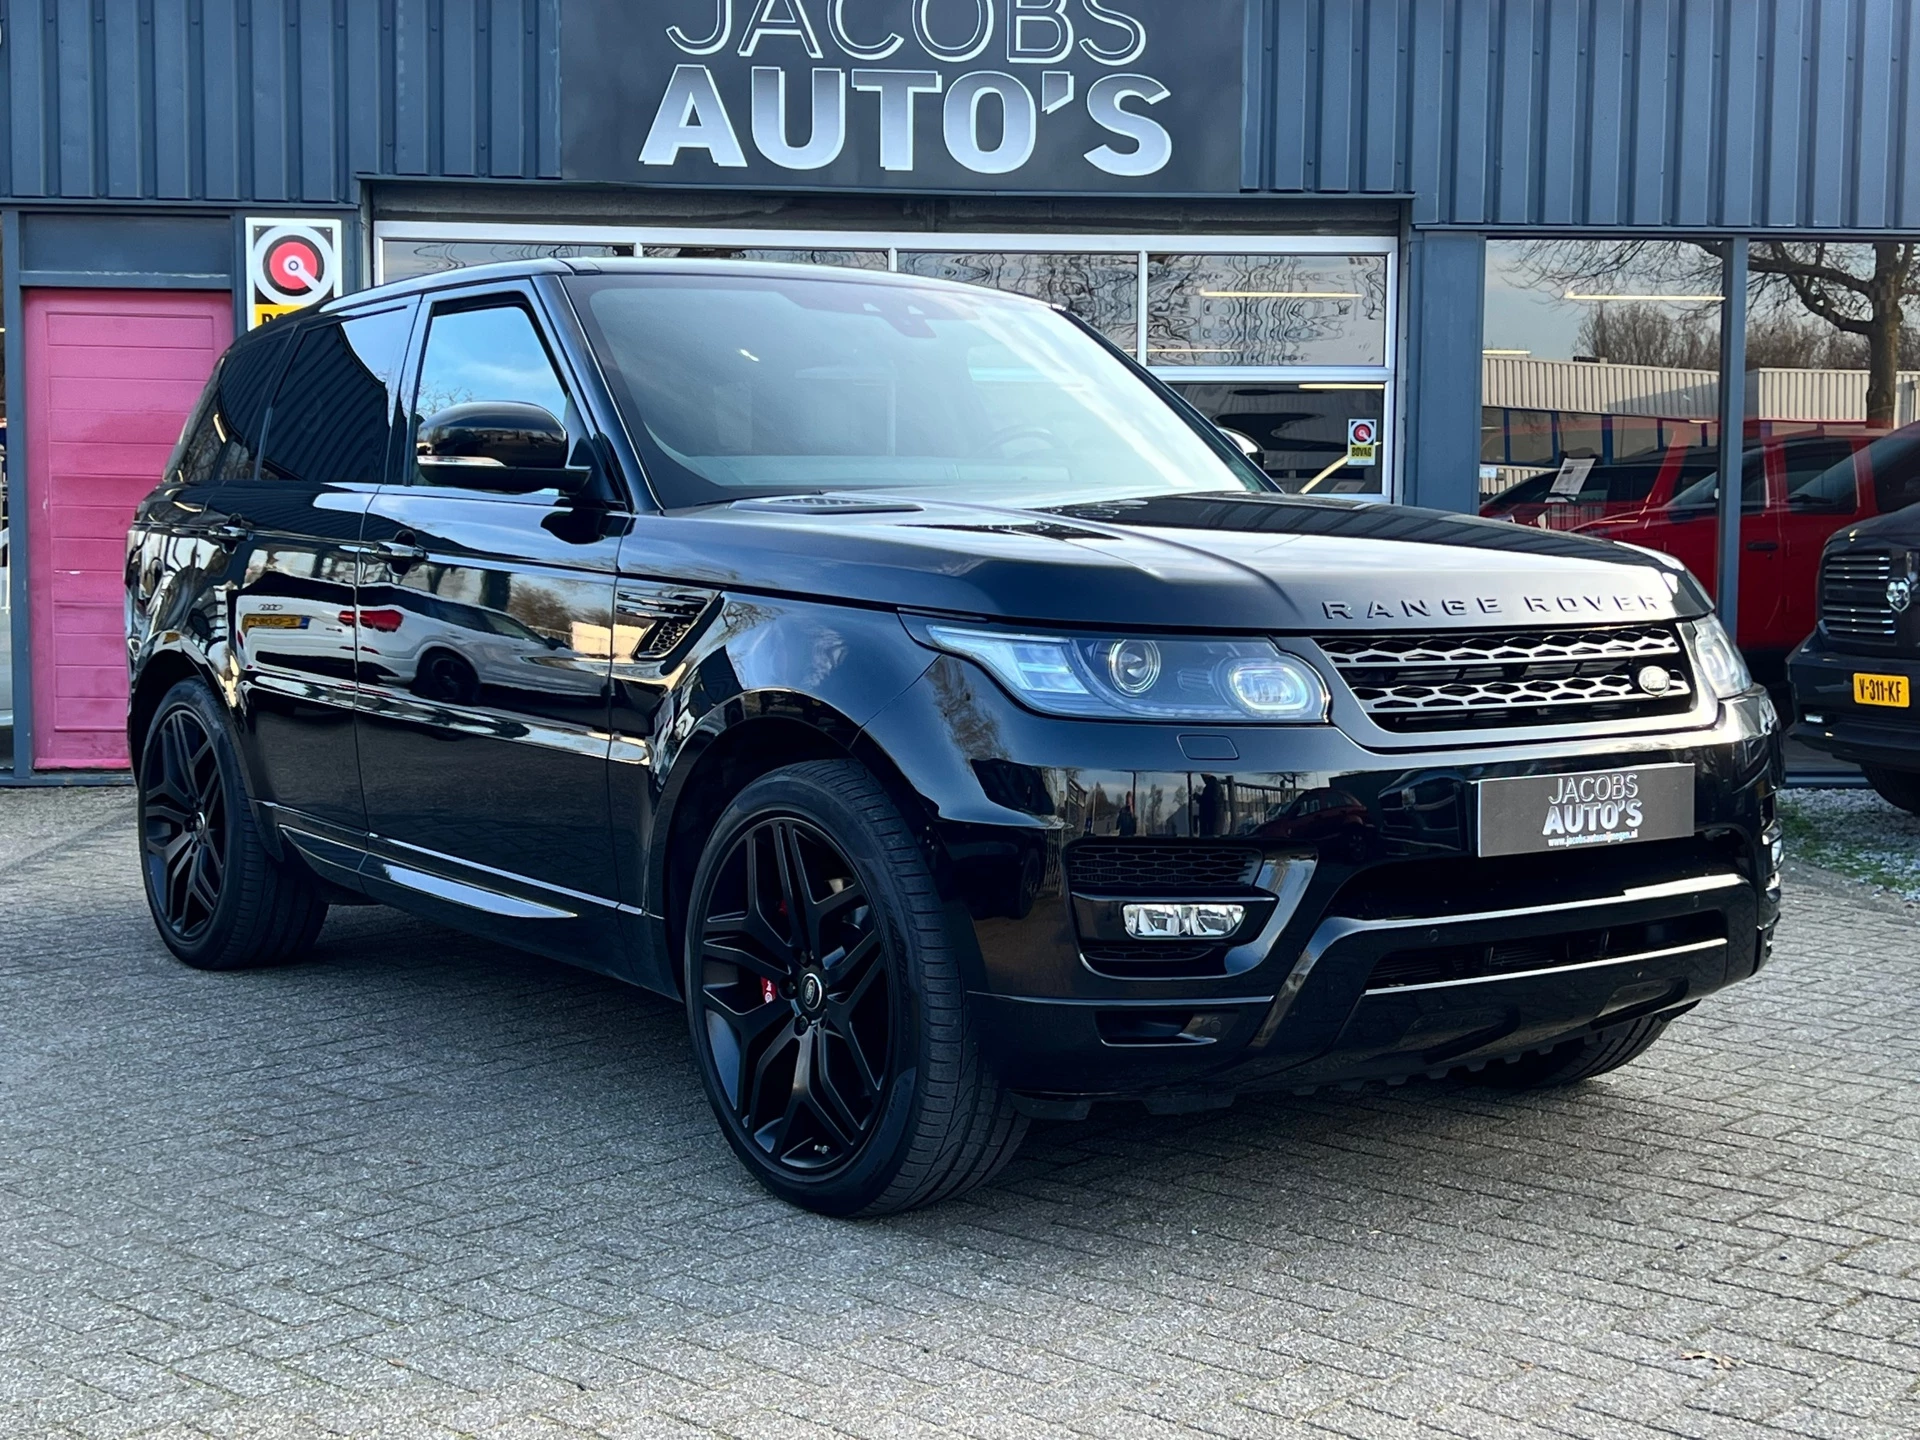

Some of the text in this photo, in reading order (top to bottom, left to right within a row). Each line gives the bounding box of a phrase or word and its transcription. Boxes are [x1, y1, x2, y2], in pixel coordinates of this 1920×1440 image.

[665, 0, 1147, 66] JACOBS
[638, 64, 1172, 177] AUTO'S
[1321, 596, 1657, 619] RANGE ROVER
[1859, 678, 1902, 703] V-311-KF
[1548, 773, 1639, 804] JACOBS
[1542, 799, 1644, 836] AUTO'S
